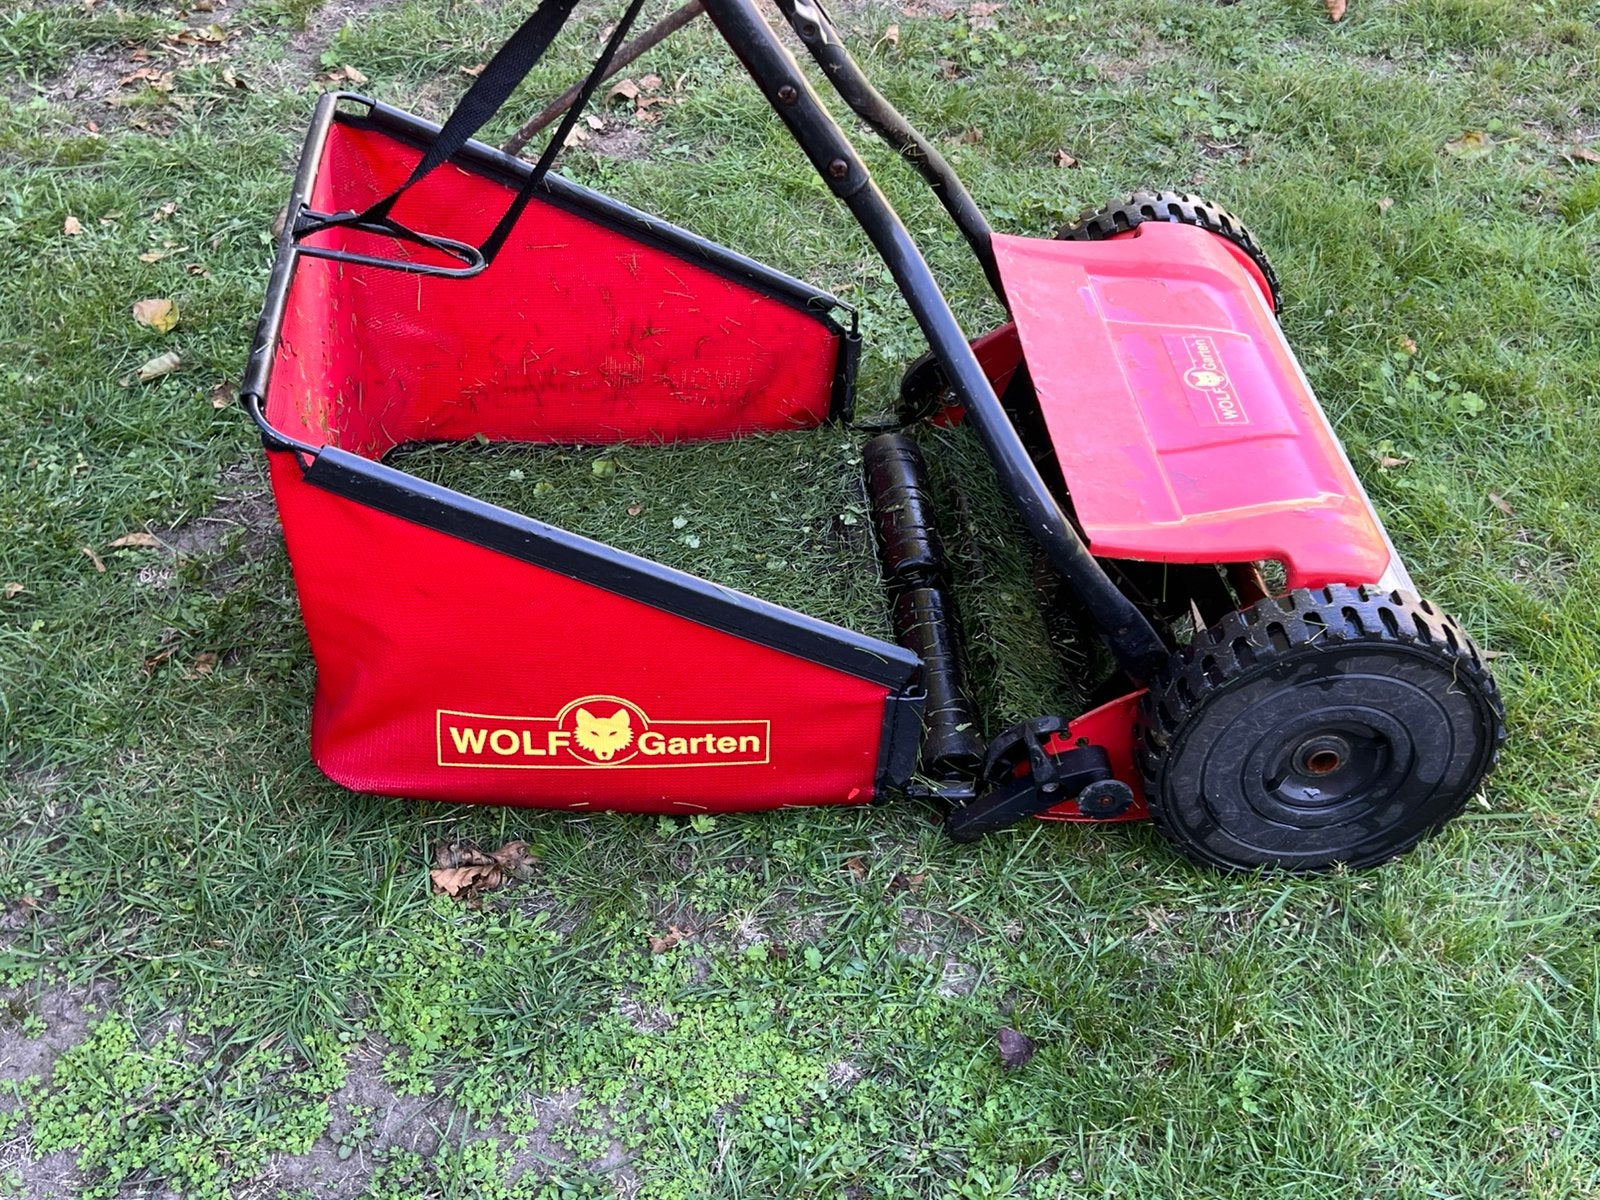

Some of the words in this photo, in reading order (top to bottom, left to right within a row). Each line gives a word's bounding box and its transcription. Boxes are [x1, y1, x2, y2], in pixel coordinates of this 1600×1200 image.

[1195, 339, 1217, 370] Garten
[1212, 387, 1238, 419] WOLF
[449, 727, 571, 756] WOLF
[637, 731, 760, 755] Garten
